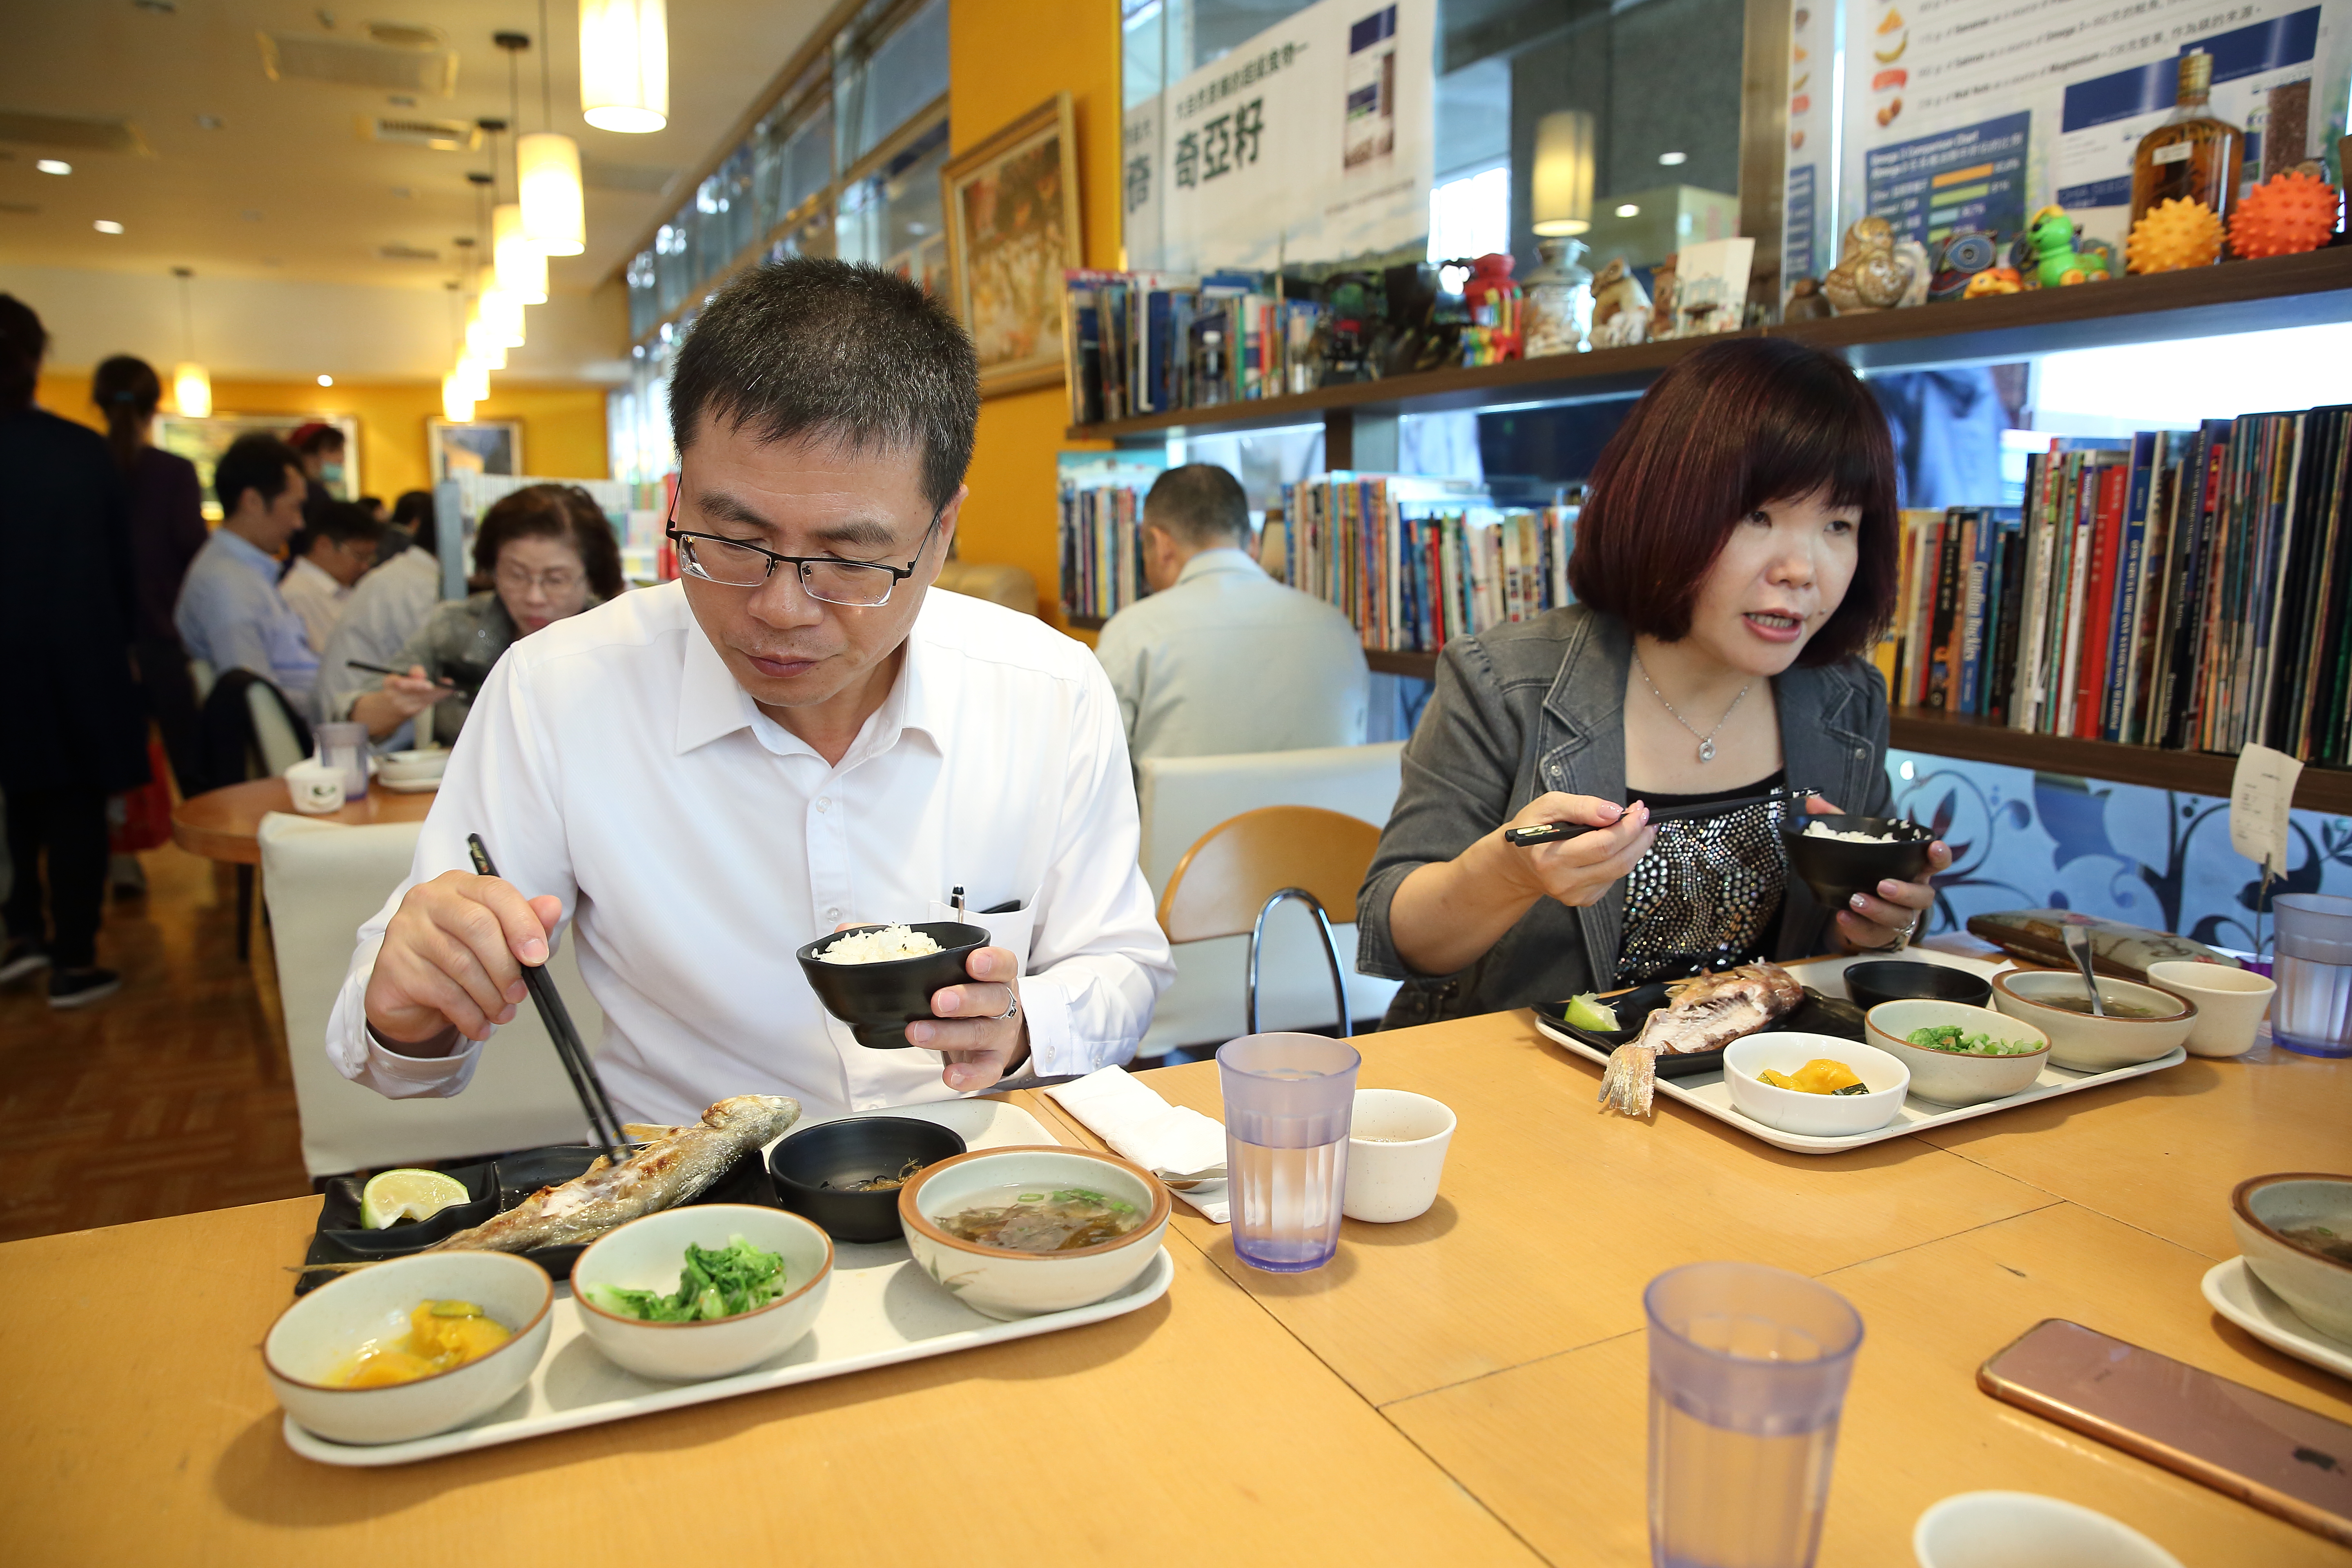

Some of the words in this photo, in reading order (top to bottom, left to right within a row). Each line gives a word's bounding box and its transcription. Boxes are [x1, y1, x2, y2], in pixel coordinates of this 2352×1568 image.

[1175, 97, 1264, 189] 奇亞籽
[1967, 560, 1989, 616] Canadian
[1963, 614, 1982, 662] Rockies
